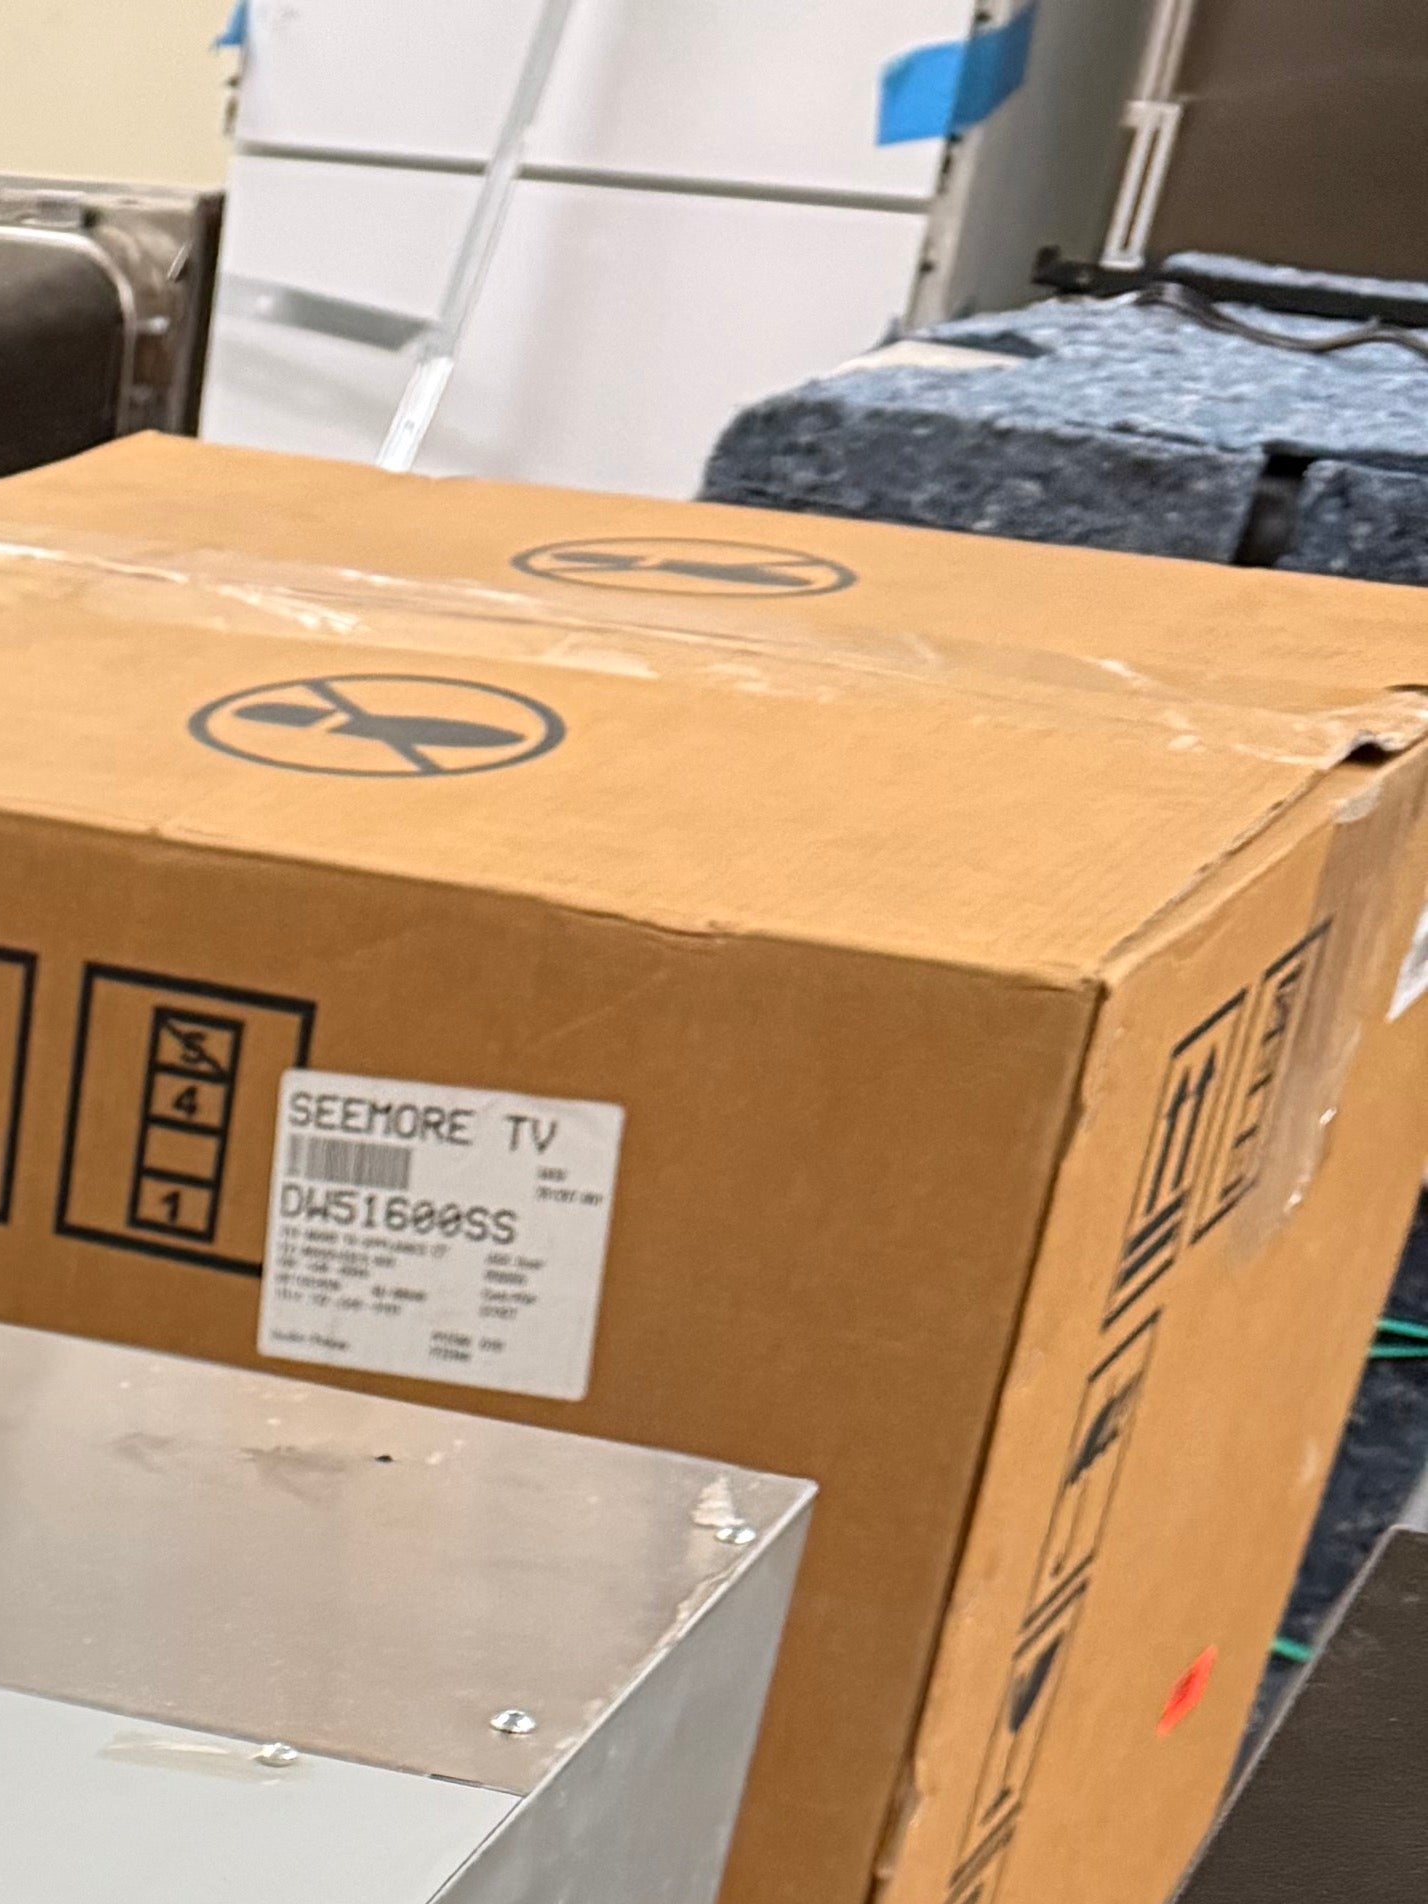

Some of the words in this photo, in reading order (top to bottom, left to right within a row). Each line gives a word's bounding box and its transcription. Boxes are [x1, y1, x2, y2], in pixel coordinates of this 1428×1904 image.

[173, 1085, 199, 1117] 4
[288, 1091, 475, 1146] SEEMORE
[504, 1113, 557, 1153] TV
[162, 1190, 181, 1224] 1
[279, 1182, 518, 1245] DW51600SS
